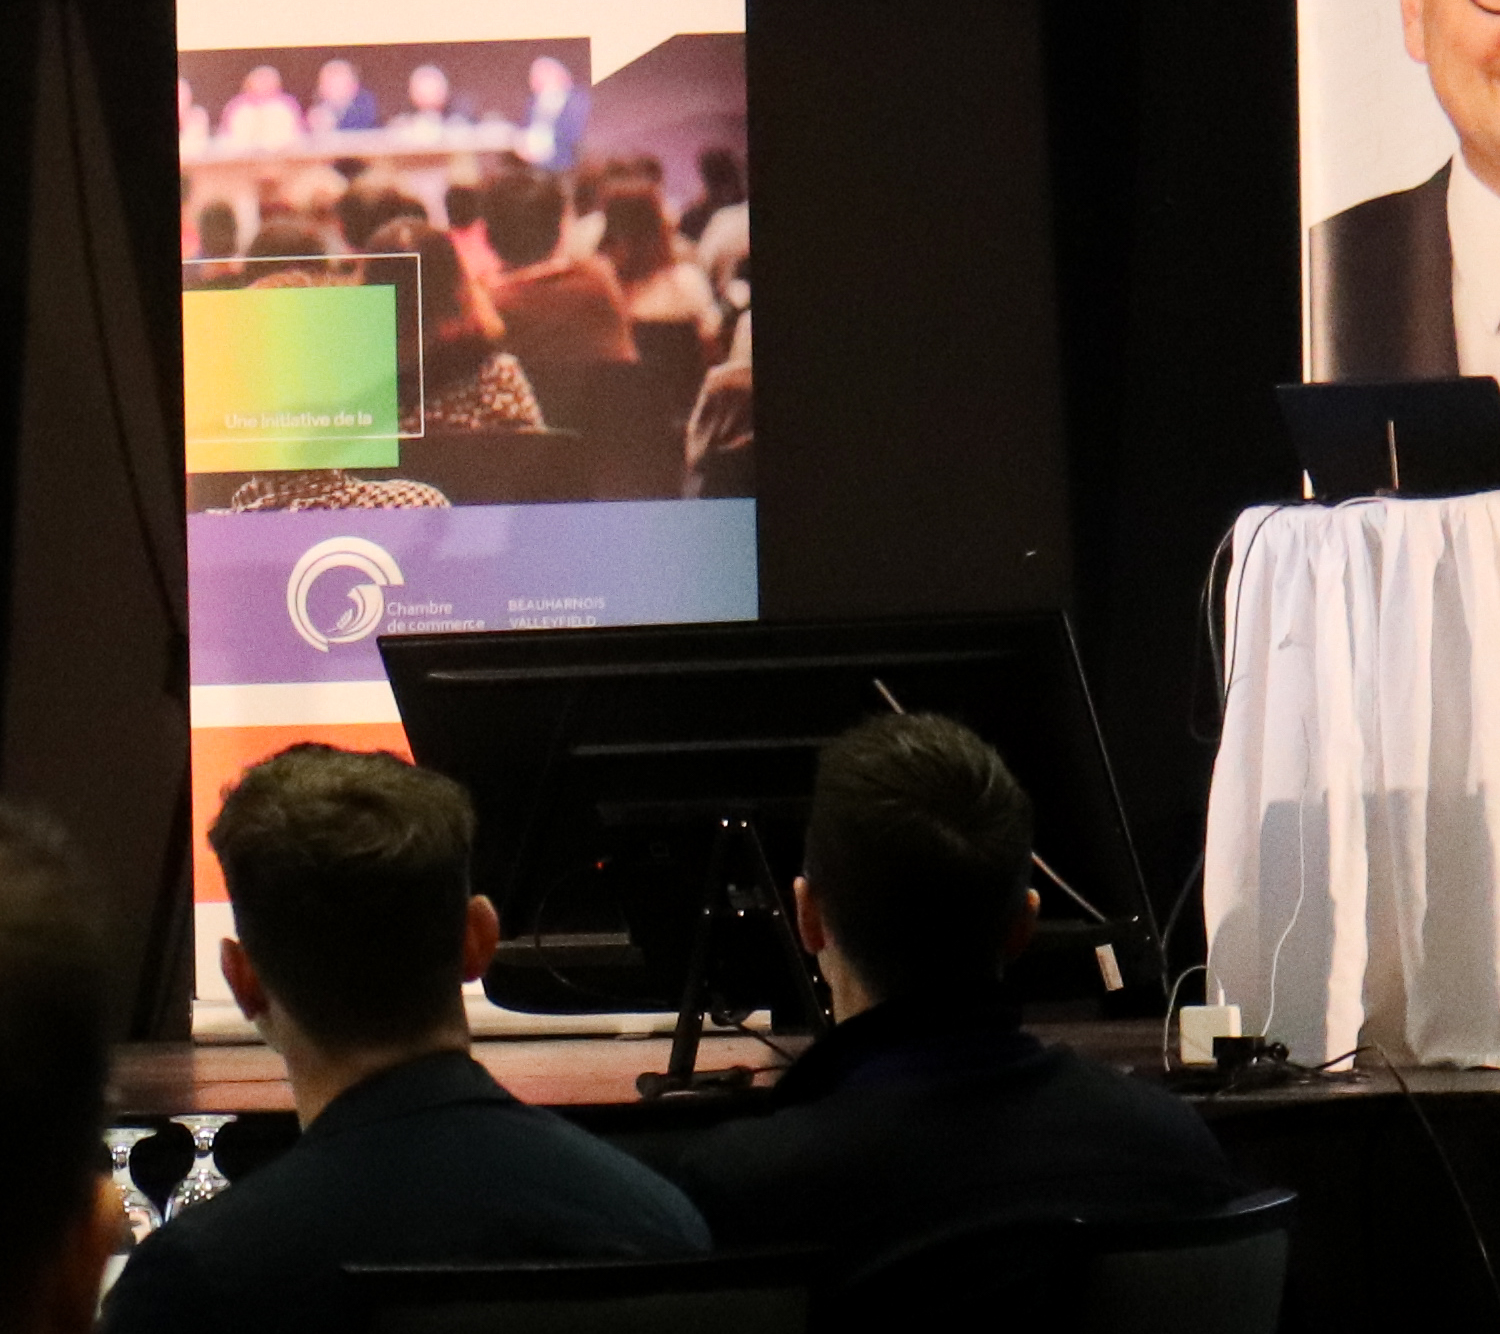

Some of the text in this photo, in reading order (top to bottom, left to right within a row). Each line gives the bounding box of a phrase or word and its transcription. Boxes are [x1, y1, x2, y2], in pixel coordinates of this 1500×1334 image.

[225, 413, 257, 429] Une
[334, 410, 354, 426] de
[387, 600, 453, 616] Chambre
[508, 597, 606, 612] BEAUHARNOIS
[387, 618, 485, 633] de commerce
[509, 615, 597, 629] VALLEYFIELD
